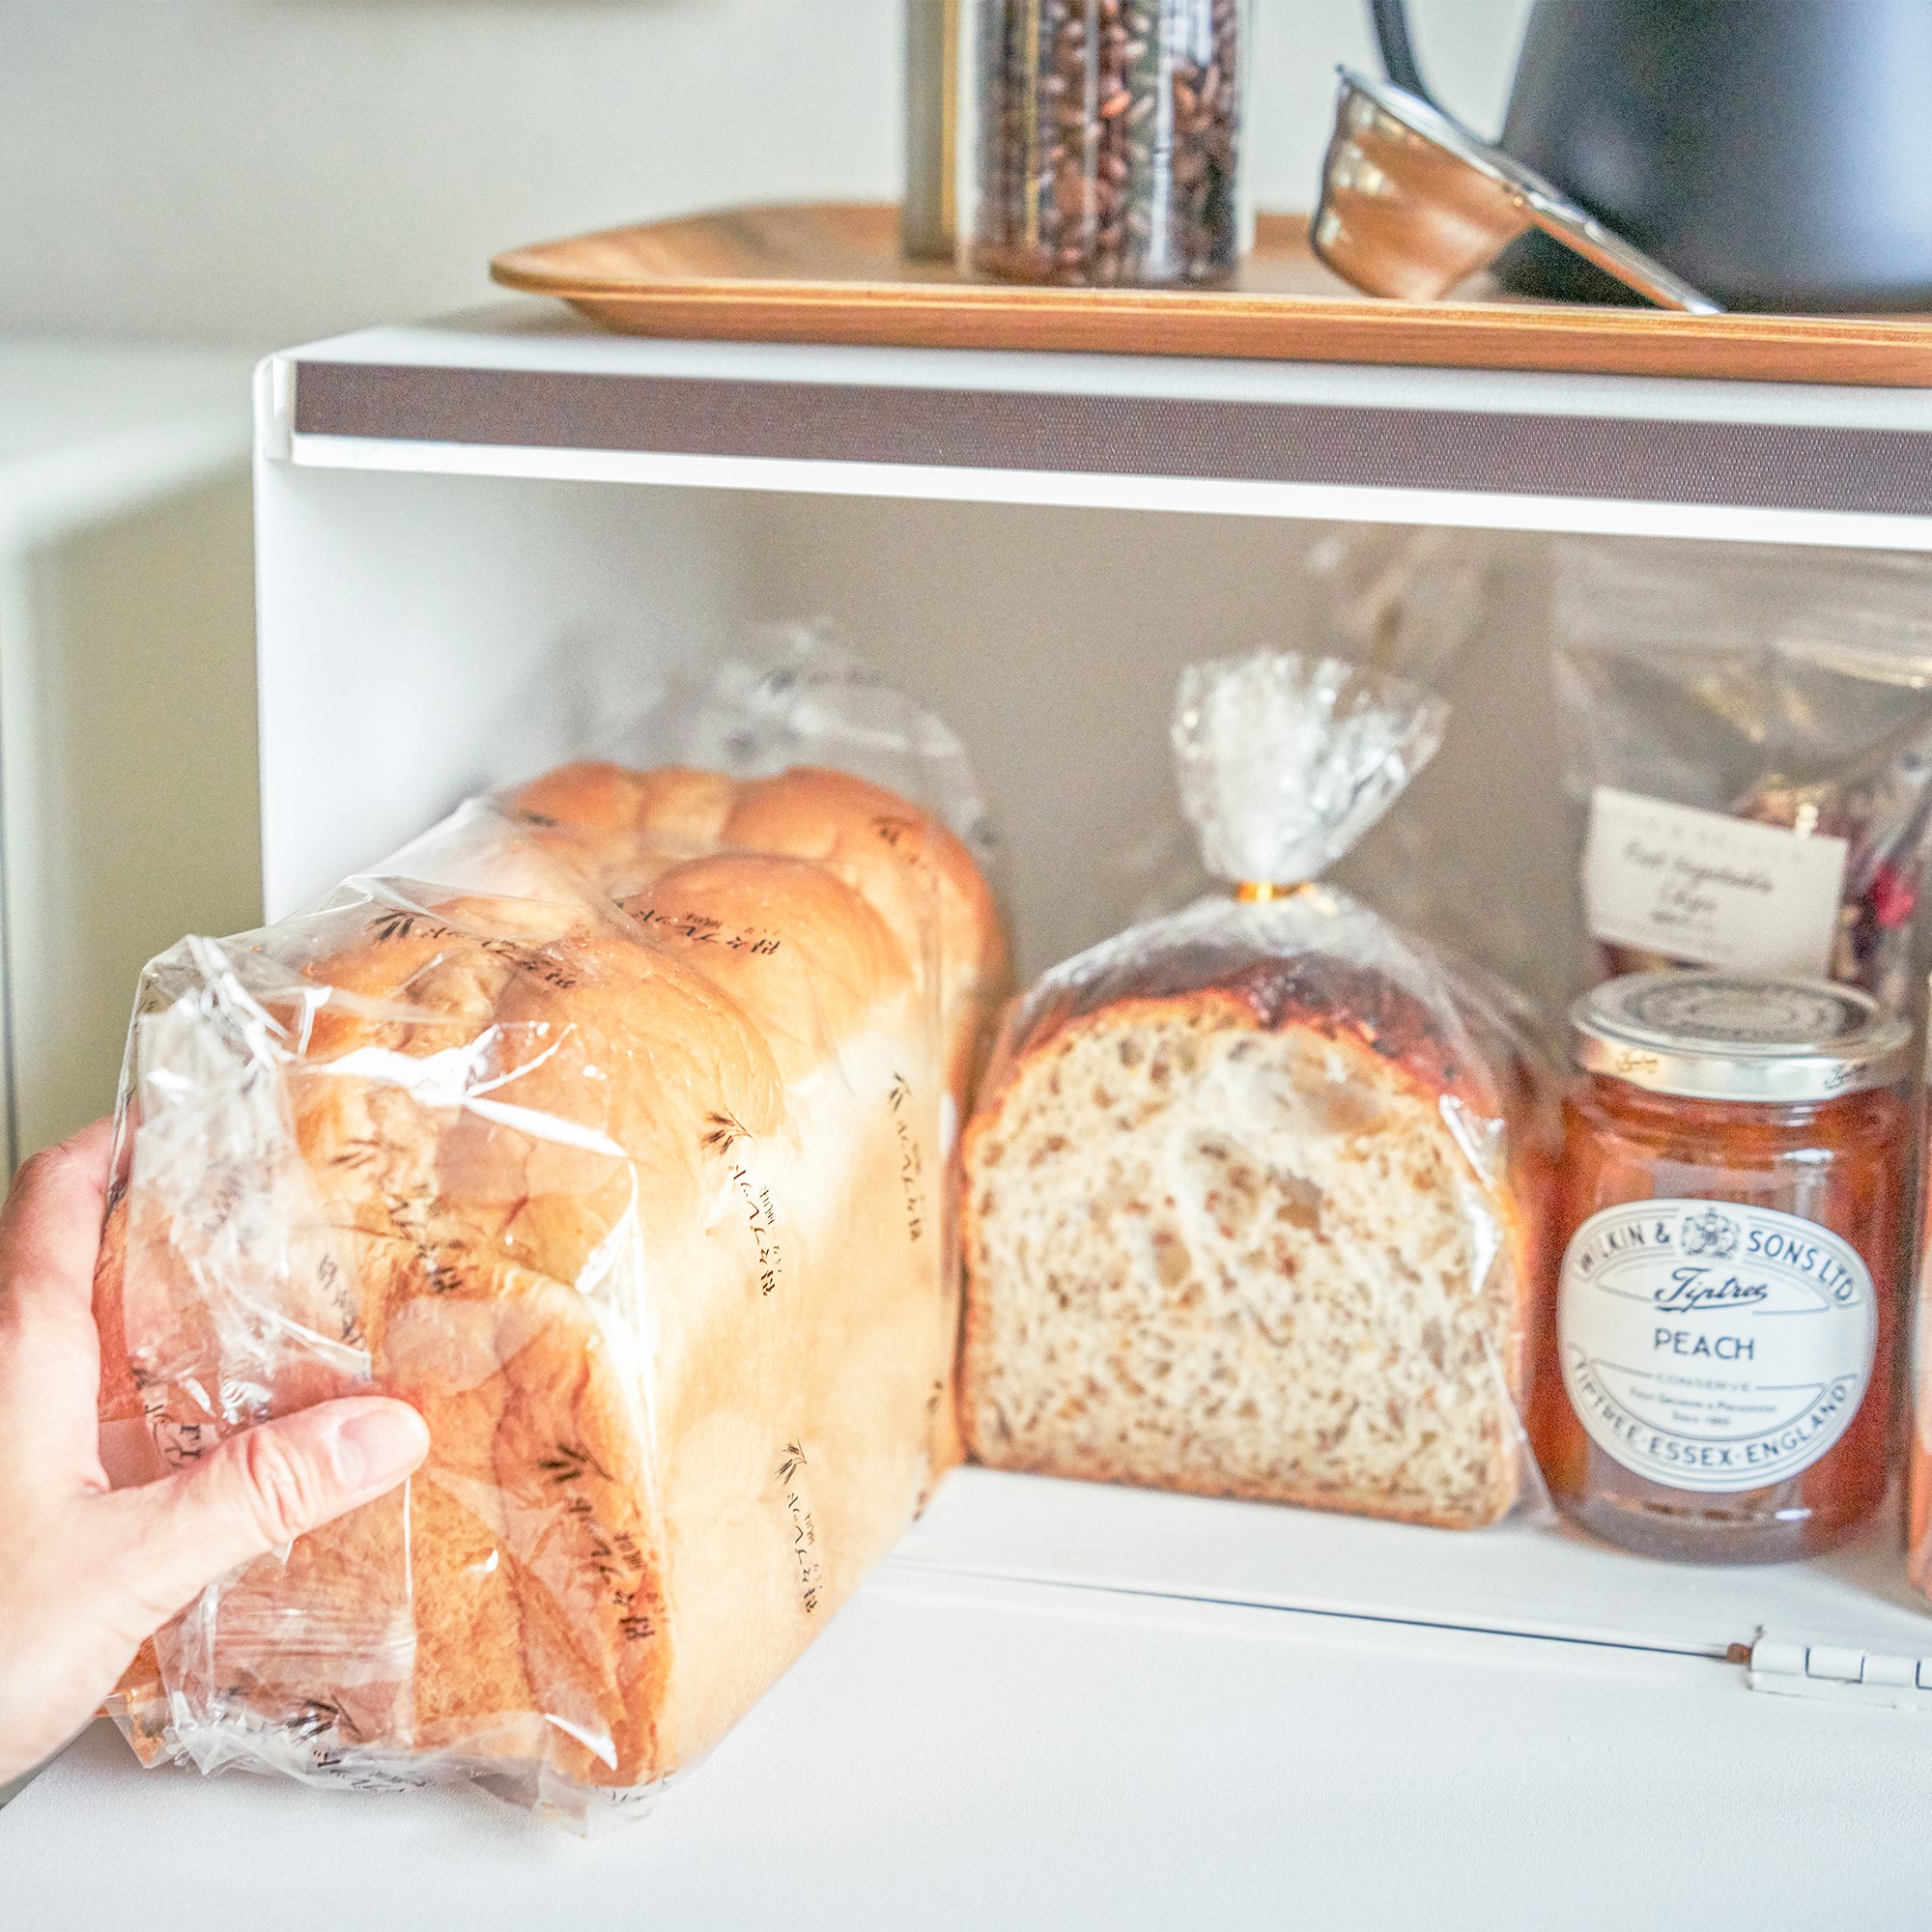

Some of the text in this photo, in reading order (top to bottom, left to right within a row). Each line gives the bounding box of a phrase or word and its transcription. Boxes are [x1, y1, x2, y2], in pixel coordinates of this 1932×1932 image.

[1654, 1266, 1769, 1313] Tiptree
[1655, 1221, 1670, 1243] &
[1747, 1230, 1818, 1271] SONS
[1818, 1259, 1854, 1301] LTD
[1654, 1327, 1755, 1361] PEACH
[1649, 1436, 1733, 1465] ESSEX
[1746, 1383, 1846, 1463] ENGLAND
